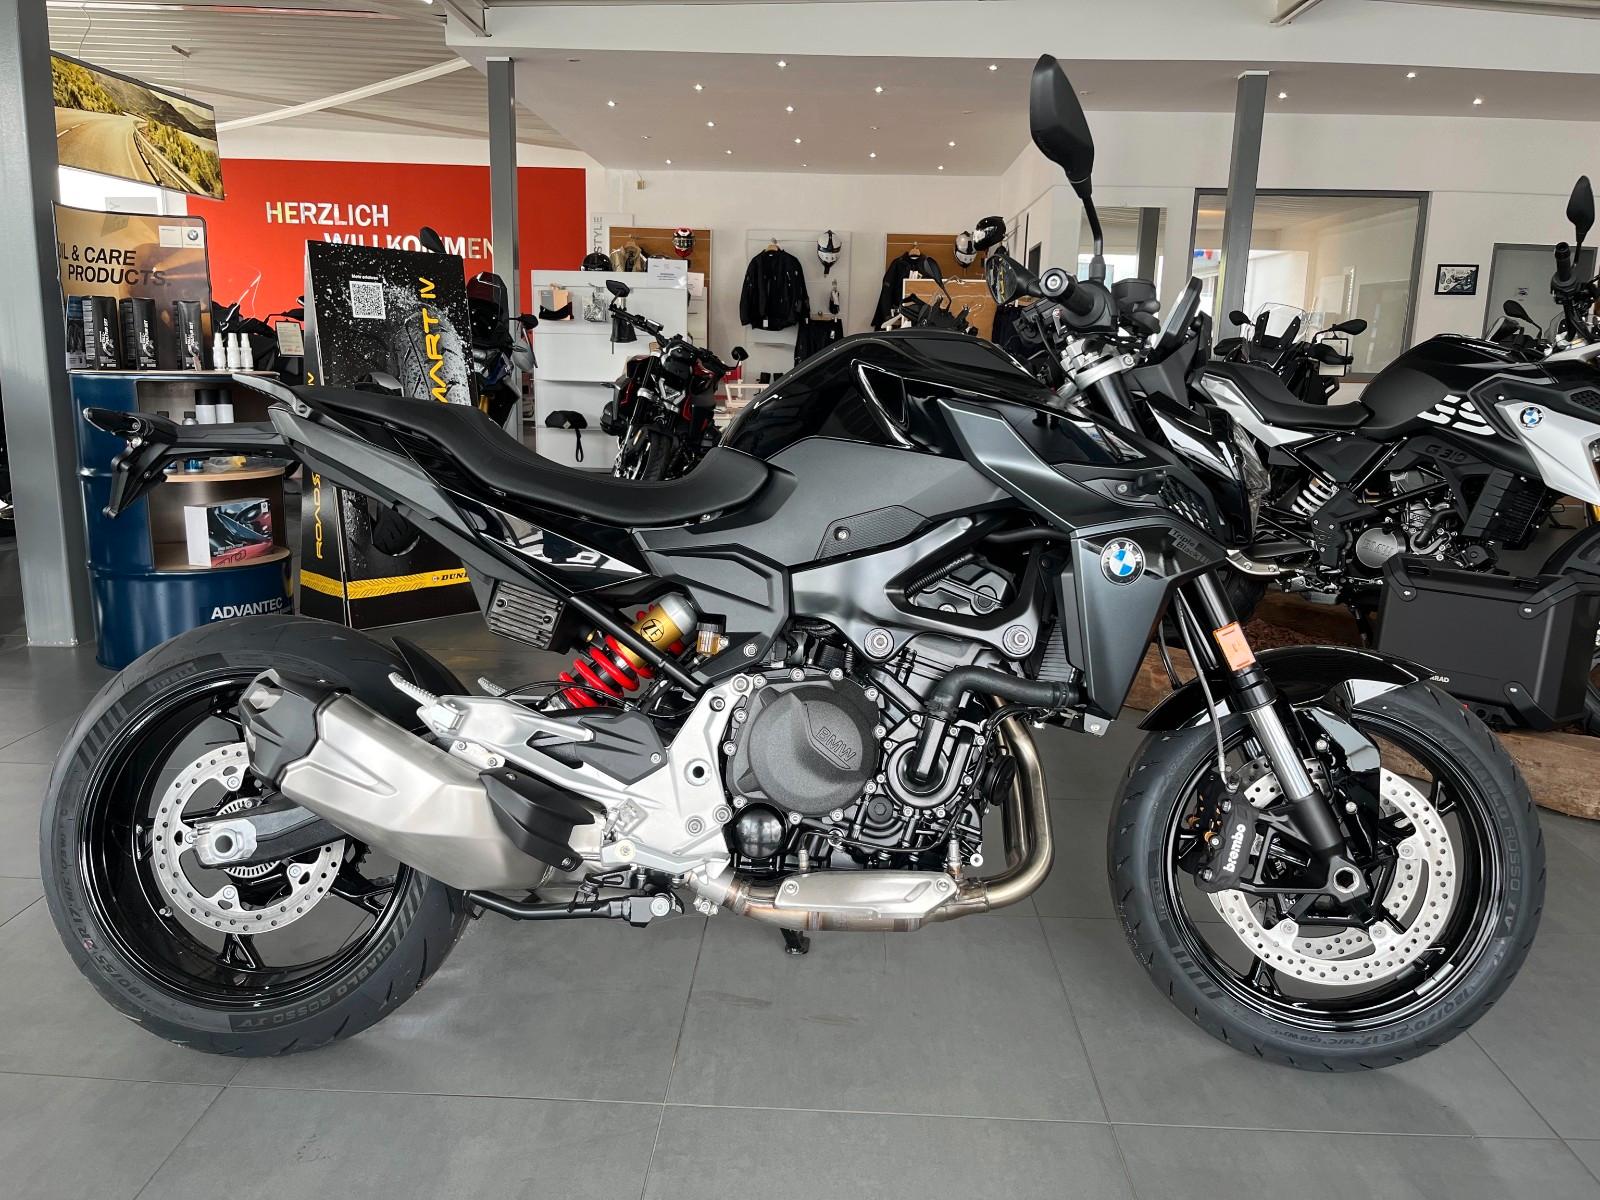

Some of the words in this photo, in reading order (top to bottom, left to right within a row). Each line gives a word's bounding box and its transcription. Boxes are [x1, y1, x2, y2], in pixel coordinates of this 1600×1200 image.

[266, 201, 389, 227] HERZLICH
[324, 232, 494, 259] WILLKOMEN
[593, 216, 603, 254] STYLE
[72, 244, 80, 261] &
[85, 247, 136, 266] CARE
[68, 264, 172, 287] PRODUCTS.
[419, 277, 437, 299] IV
[1362, 538, 1394, 558] BMW
[211, 597, 283, 620] ADVANTEC
[641, 618, 664, 642] ZF
[816, 726, 857, 762] BMW
[1223, 823, 1246, 873] brembo
